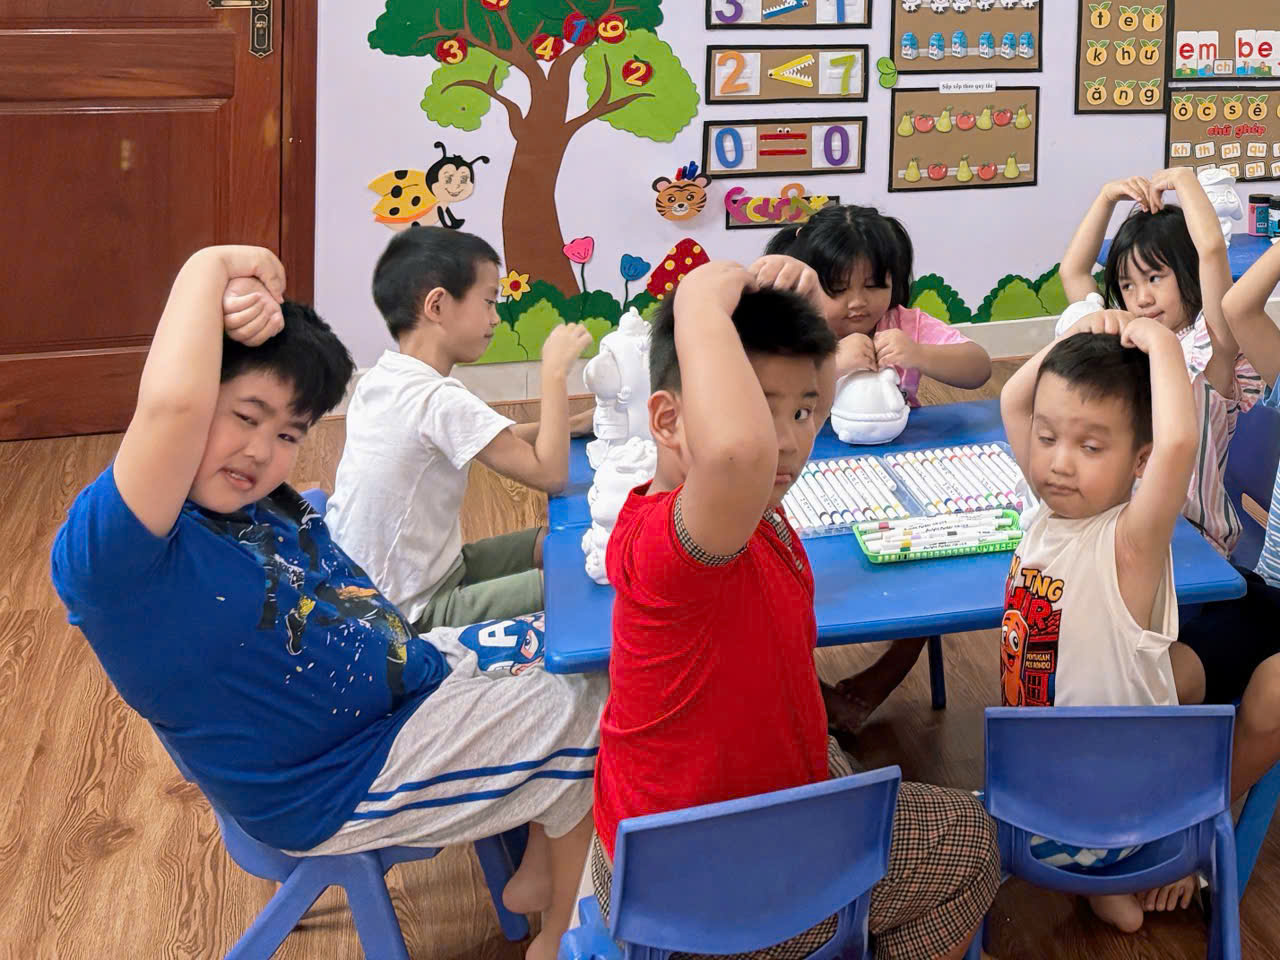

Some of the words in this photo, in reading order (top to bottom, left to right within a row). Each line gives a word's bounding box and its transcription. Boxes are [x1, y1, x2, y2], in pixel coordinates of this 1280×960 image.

[1097, 11, 1104, 25] t
[1124, 16, 1134, 26] e
[1151, 15, 1155, 27] i
[443, 40, 463, 64] 3
[536, 36, 555, 60] 4
[1093, 48, 1102, 61] k
[1122, 48, 1130, 60] h
[1144, 49, 1155, 60] ư
[1179, 43, 1217, 60] em
[625, 62, 647, 86] 2
[717, 51, 750, 94] 2
[830, 54, 857, 96] 7
[1216, 61, 1231, 72] ch
[1092, 87, 1102, 100] ă
[1119, 90, 1128, 100] n
[1144, 88, 1154, 102] g
[1178, 103, 1188, 117] ô
[1202, 106, 1211, 116] c
[1229, 104, 1236, 115] s
[1252, 103, 1262, 116] ê
[1207, 123, 1232, 137] chữ
[1235, 123, 1266, 138] ghép
[715, 127, 744, 169] 0
[823, 125, 850, 167] 0
[1173, 144, 1188, 155] kh
[1199, 144, 1211, 155] th
[1223, 144, 1239, 157] ph
[1249, 145, 1264, 156] qu
[1248, 163, 1263, 177] gh
